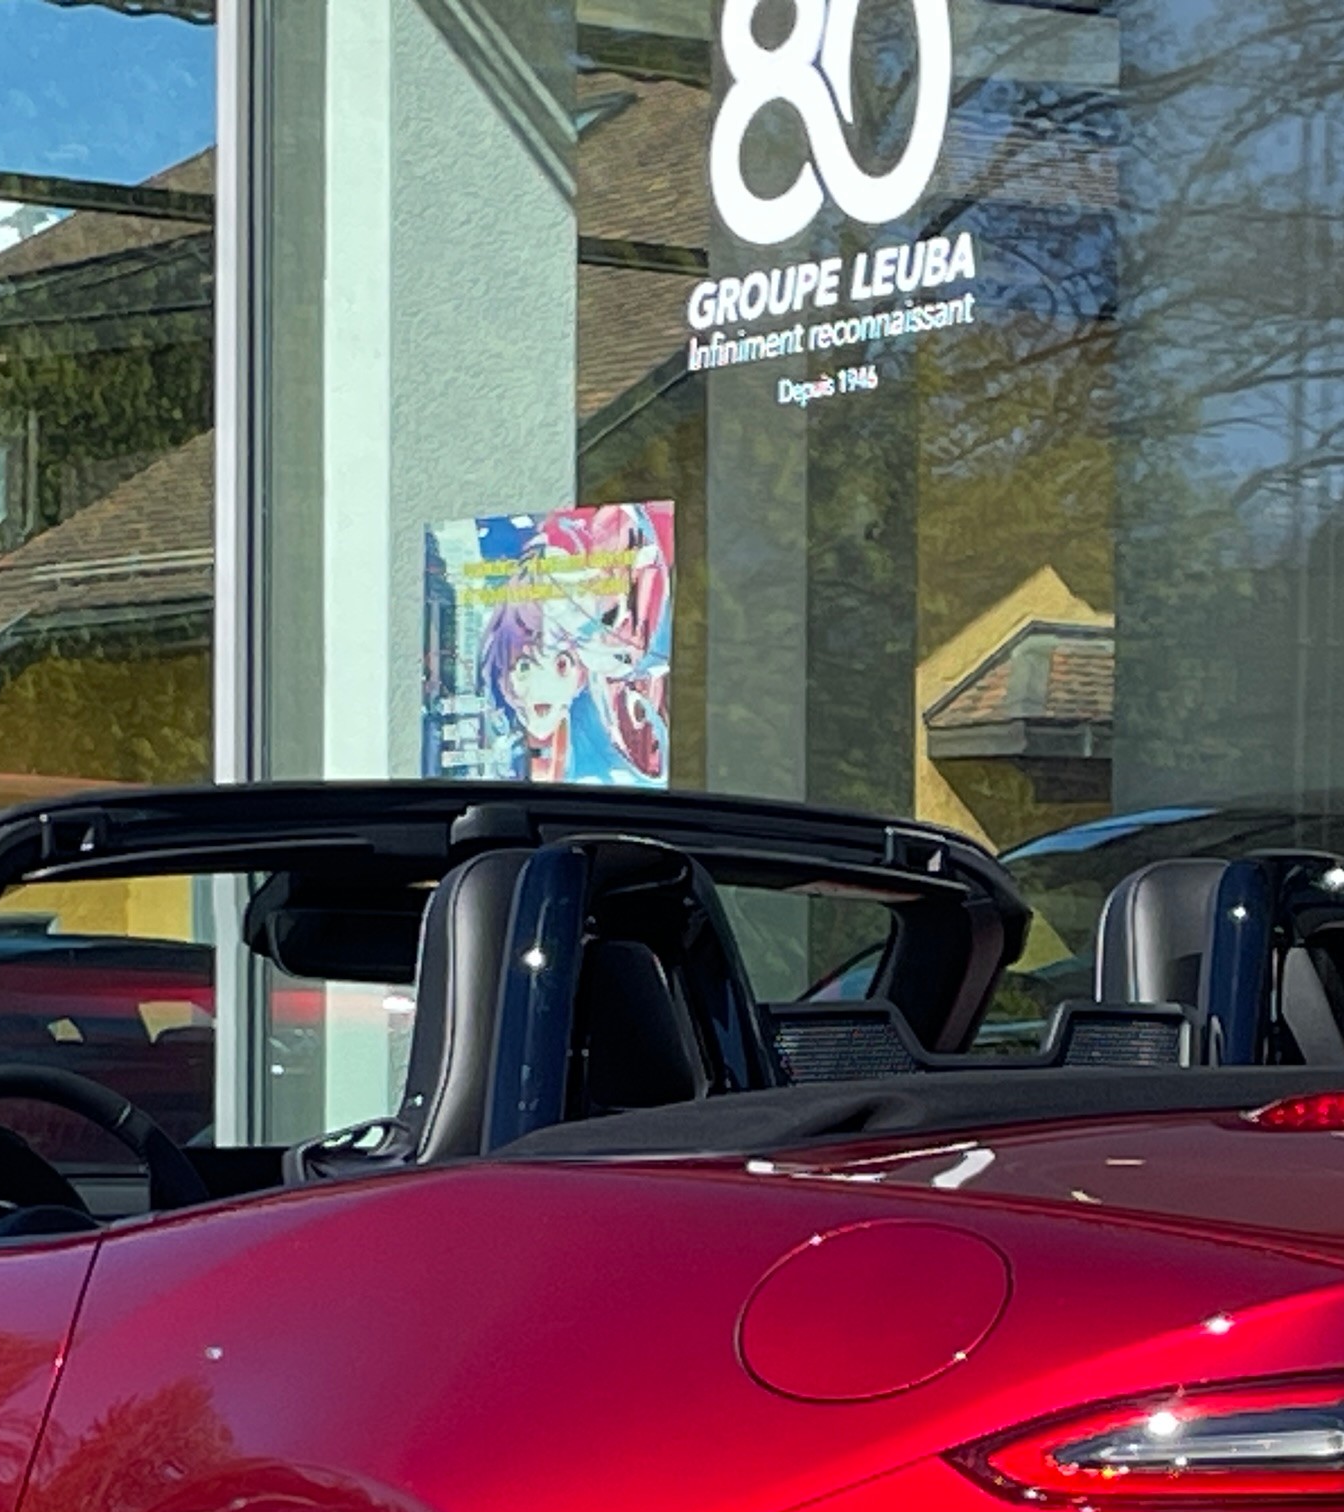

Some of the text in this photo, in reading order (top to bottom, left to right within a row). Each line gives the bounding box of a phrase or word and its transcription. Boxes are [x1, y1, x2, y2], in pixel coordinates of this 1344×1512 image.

[710, 0, 954, 244] 80
[687, 232, 975, 330] GROUPE LEUBA
[687, 291, 976, 372] Infiniment reconnaissant
[776, 364, 879, 408] Depuis 1946
